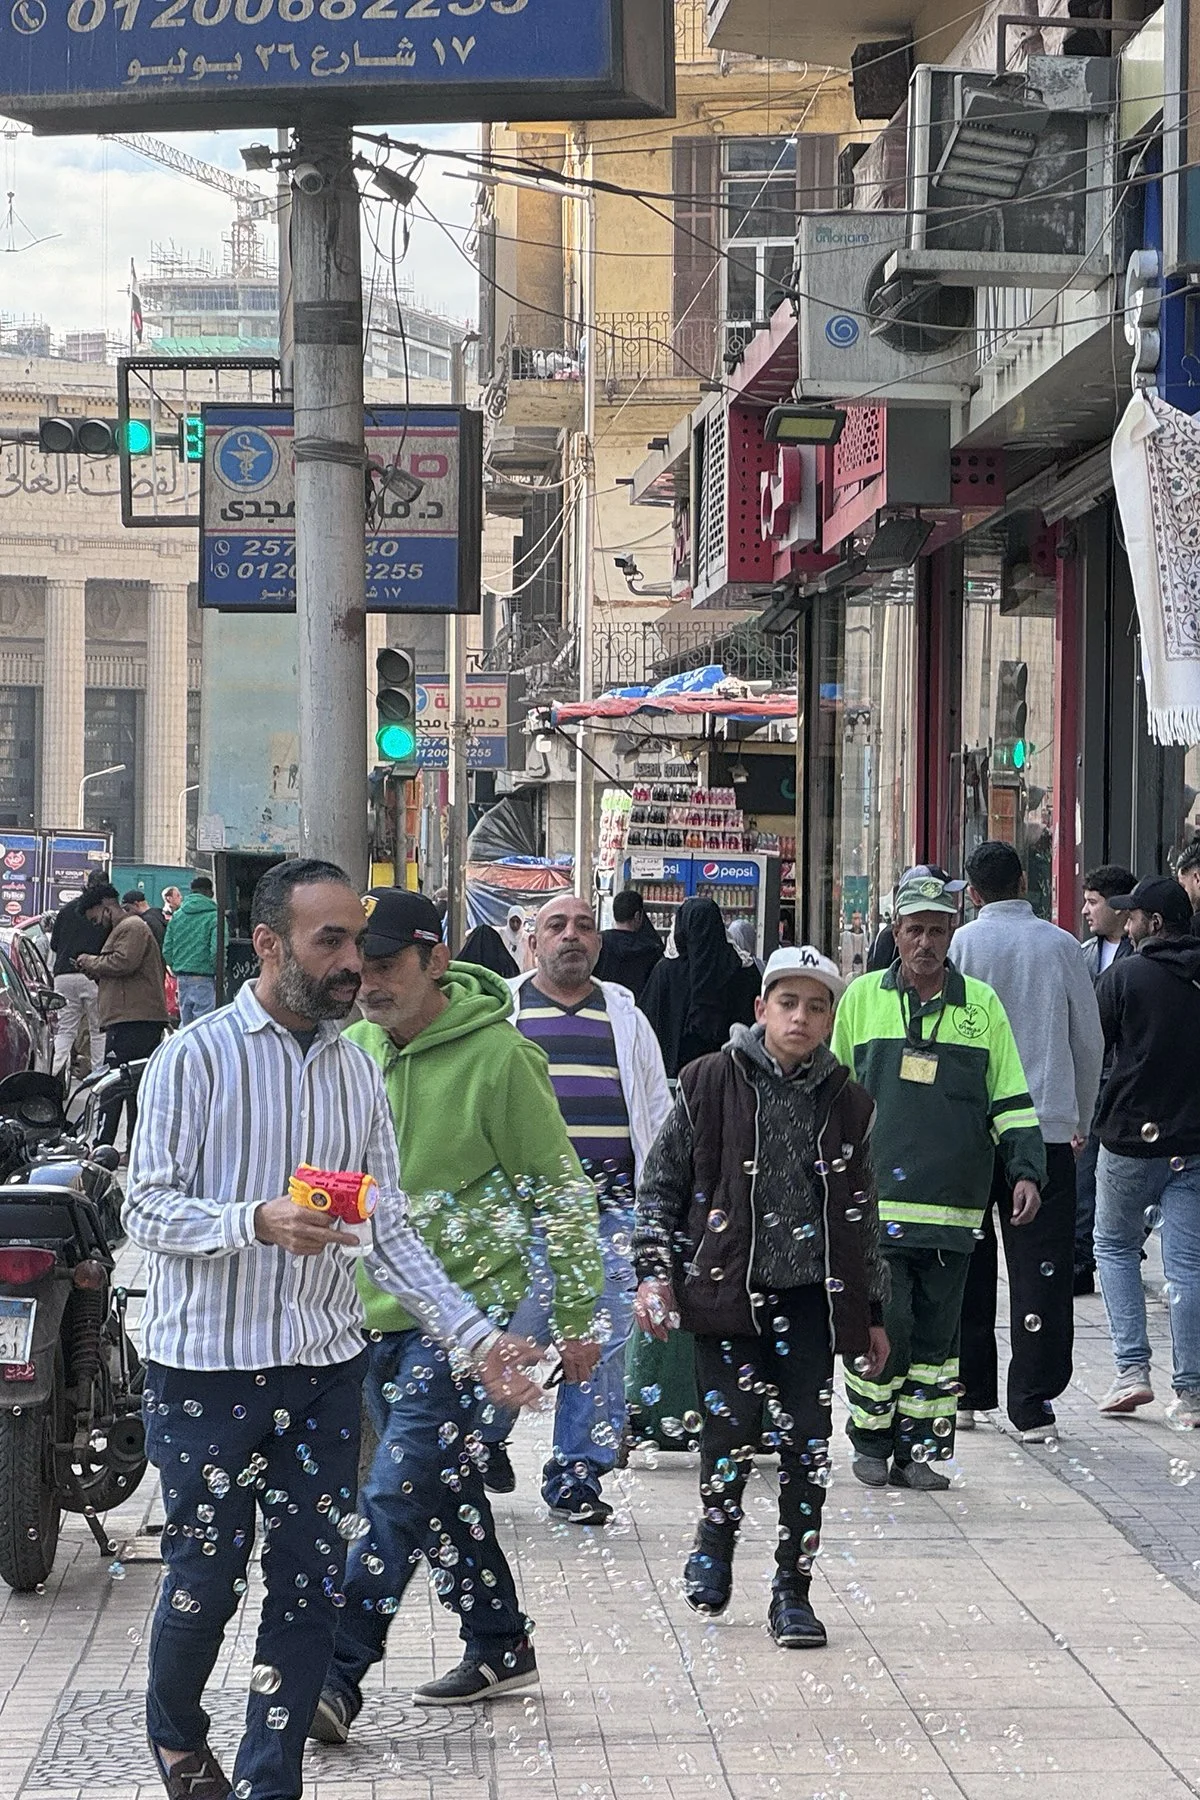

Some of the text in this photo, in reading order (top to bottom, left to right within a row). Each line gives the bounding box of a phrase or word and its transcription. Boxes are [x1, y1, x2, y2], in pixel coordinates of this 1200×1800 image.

[121, 36, 477, 85] ١٧ شارع ٢٦ يوليو
[815, 232, 870, 244] unionaire
[242, 539, 400, 557] 25740
[236, 562, 424, 580] 0122255
[260, 586, 297, 601] وليو
[720, 866, 754, 879] pepsi
